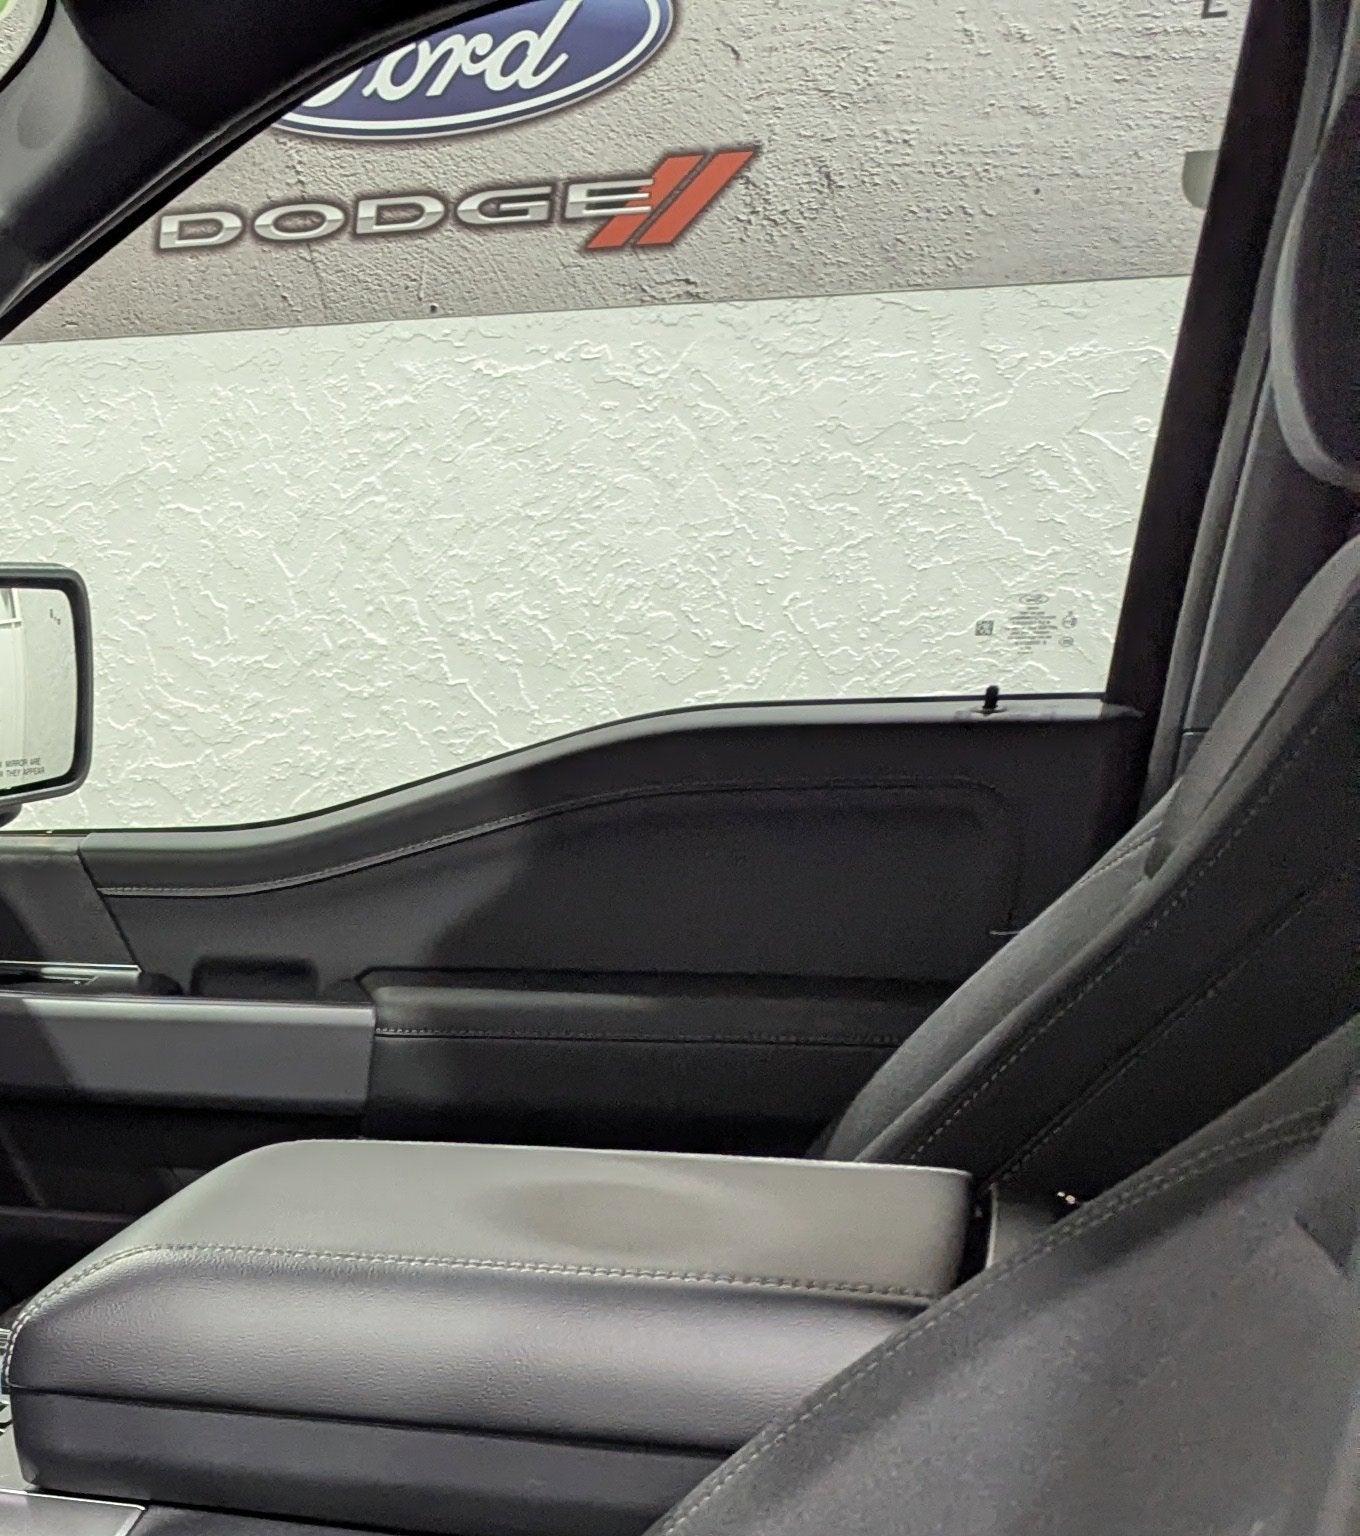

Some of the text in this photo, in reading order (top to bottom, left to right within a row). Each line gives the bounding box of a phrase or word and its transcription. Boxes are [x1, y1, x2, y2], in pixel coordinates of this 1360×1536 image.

[159, 177, 654, 249] DODGE
[6, 769, 21, 777] THEY
[23, 766, 45, 776] APPEAR
